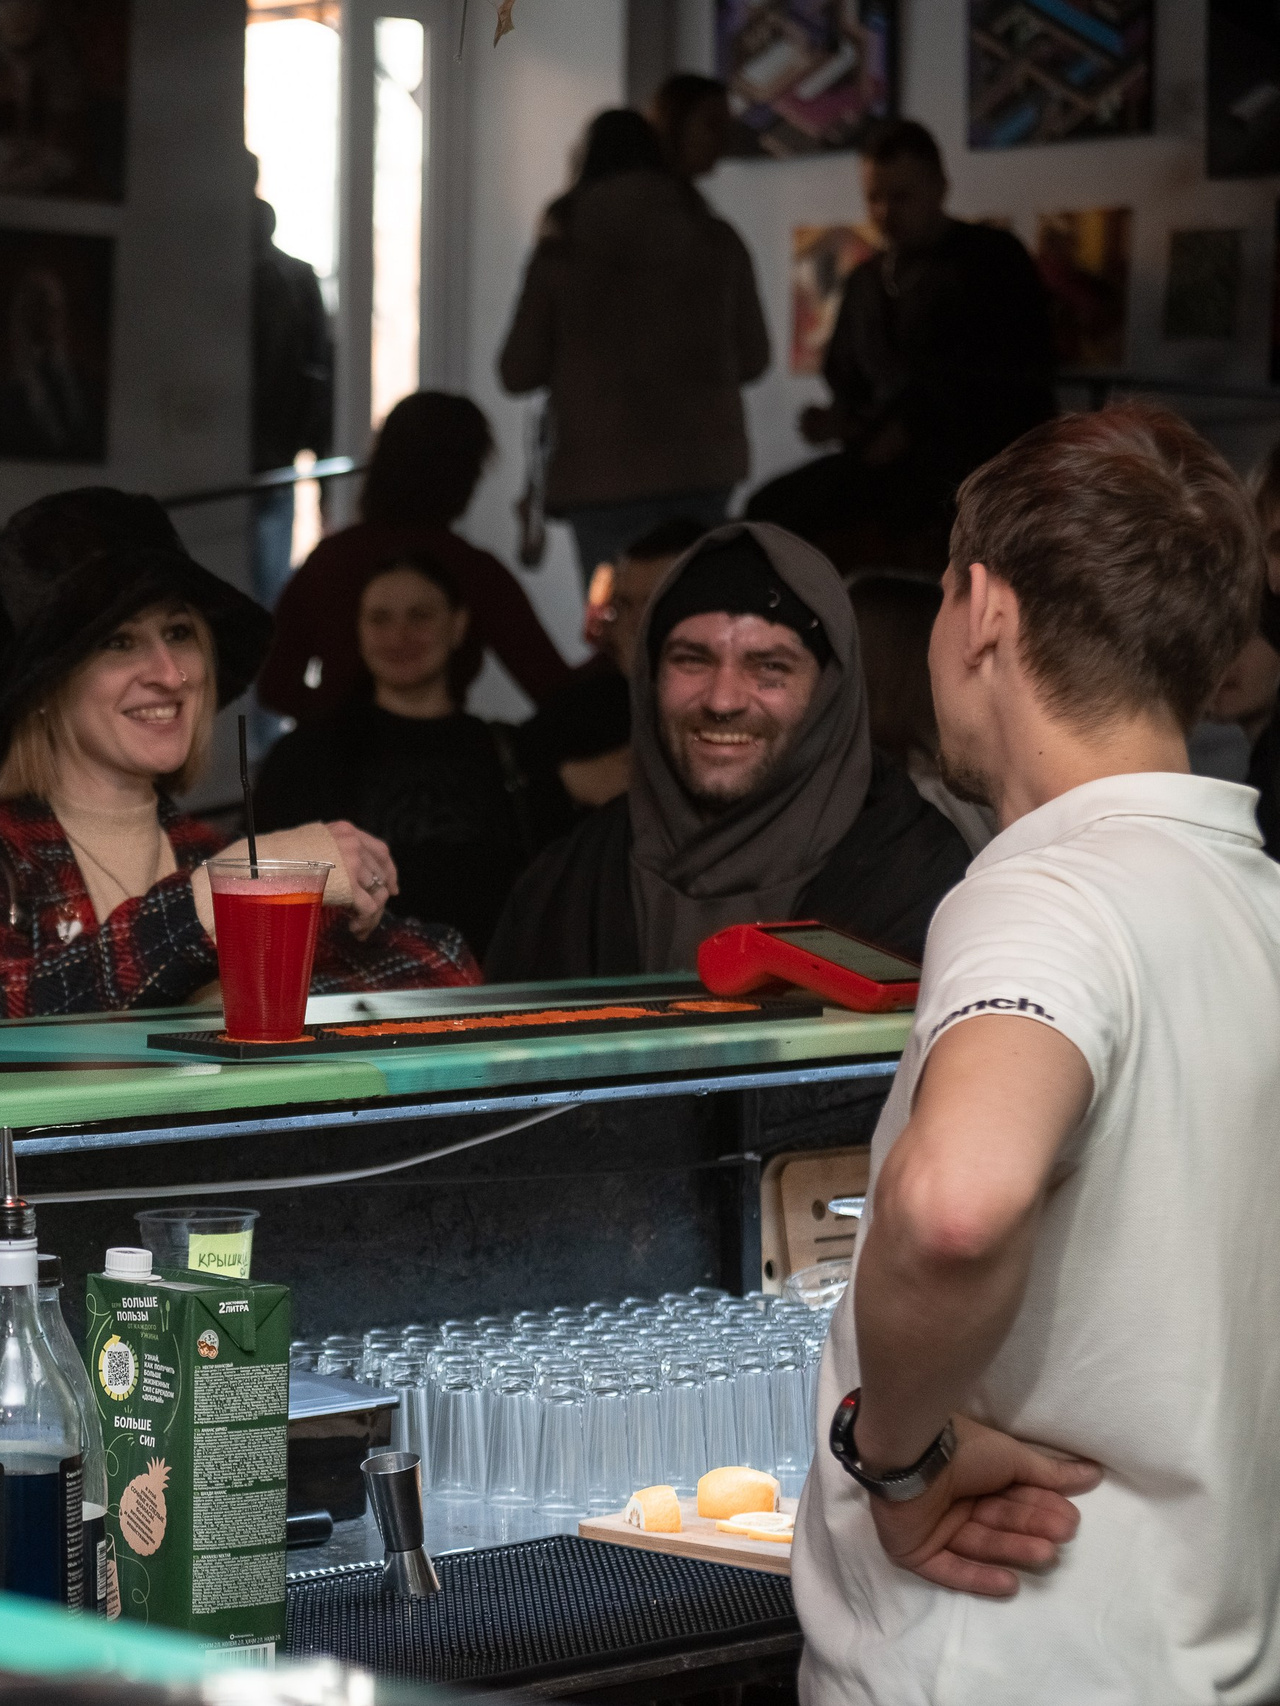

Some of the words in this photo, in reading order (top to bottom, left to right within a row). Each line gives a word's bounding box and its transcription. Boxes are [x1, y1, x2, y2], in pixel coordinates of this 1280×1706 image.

[122, 1296, 158, 1308] БОЛЬШЕ
[219, 1302, 225, 1314] 2
[226, 1305, 249, 1313] ЛИТРА
[116, 1311, 149, 1321] ПОЛЬЗЫ
[114, 1416, 152, 1431] БОЛЬШЕ
[139, 1434, 155, 1448] СИЛ
